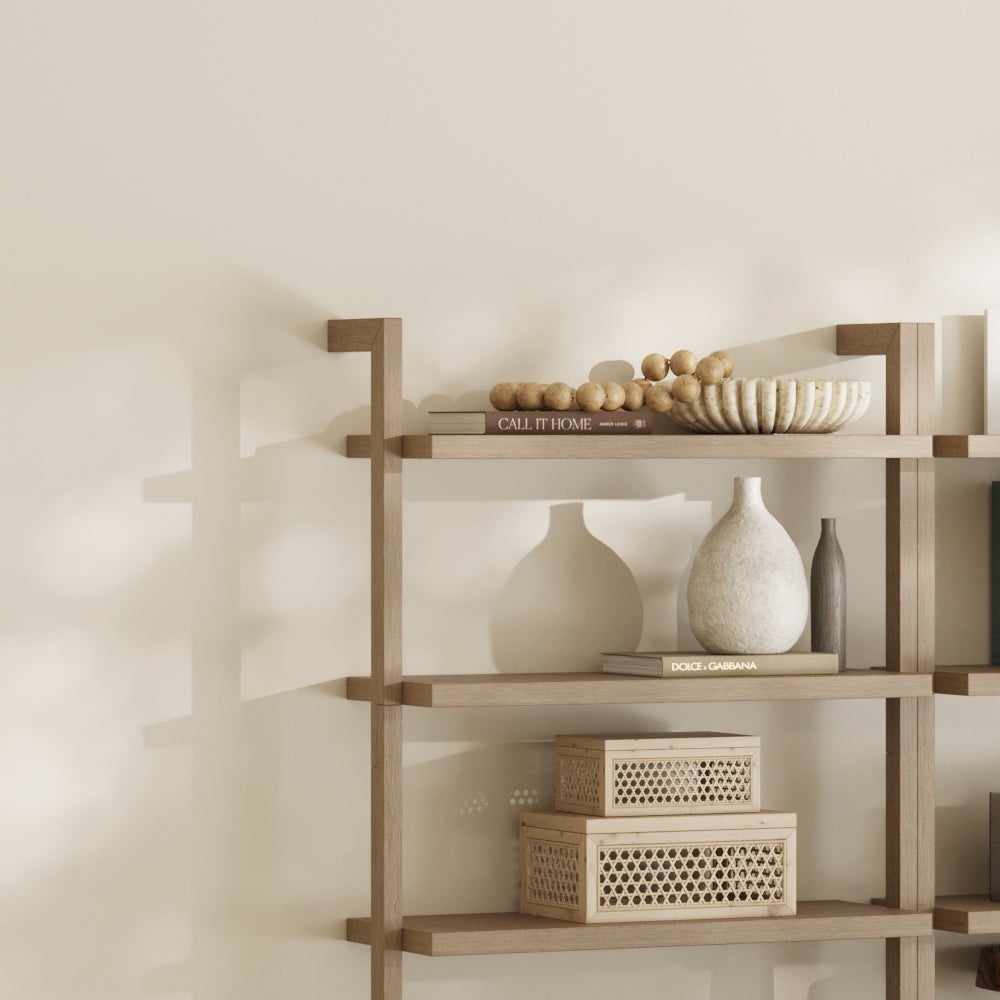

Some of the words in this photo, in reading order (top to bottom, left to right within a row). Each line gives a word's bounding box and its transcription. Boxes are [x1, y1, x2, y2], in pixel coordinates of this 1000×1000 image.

[498, 417, 532, 430] CALL
[535, 417, 548, 430] IT
[551, 417, 592, 430] HOME
[671, 662, 703, 671] DOLCE
[708, 661, 757, 671] GABBANA
